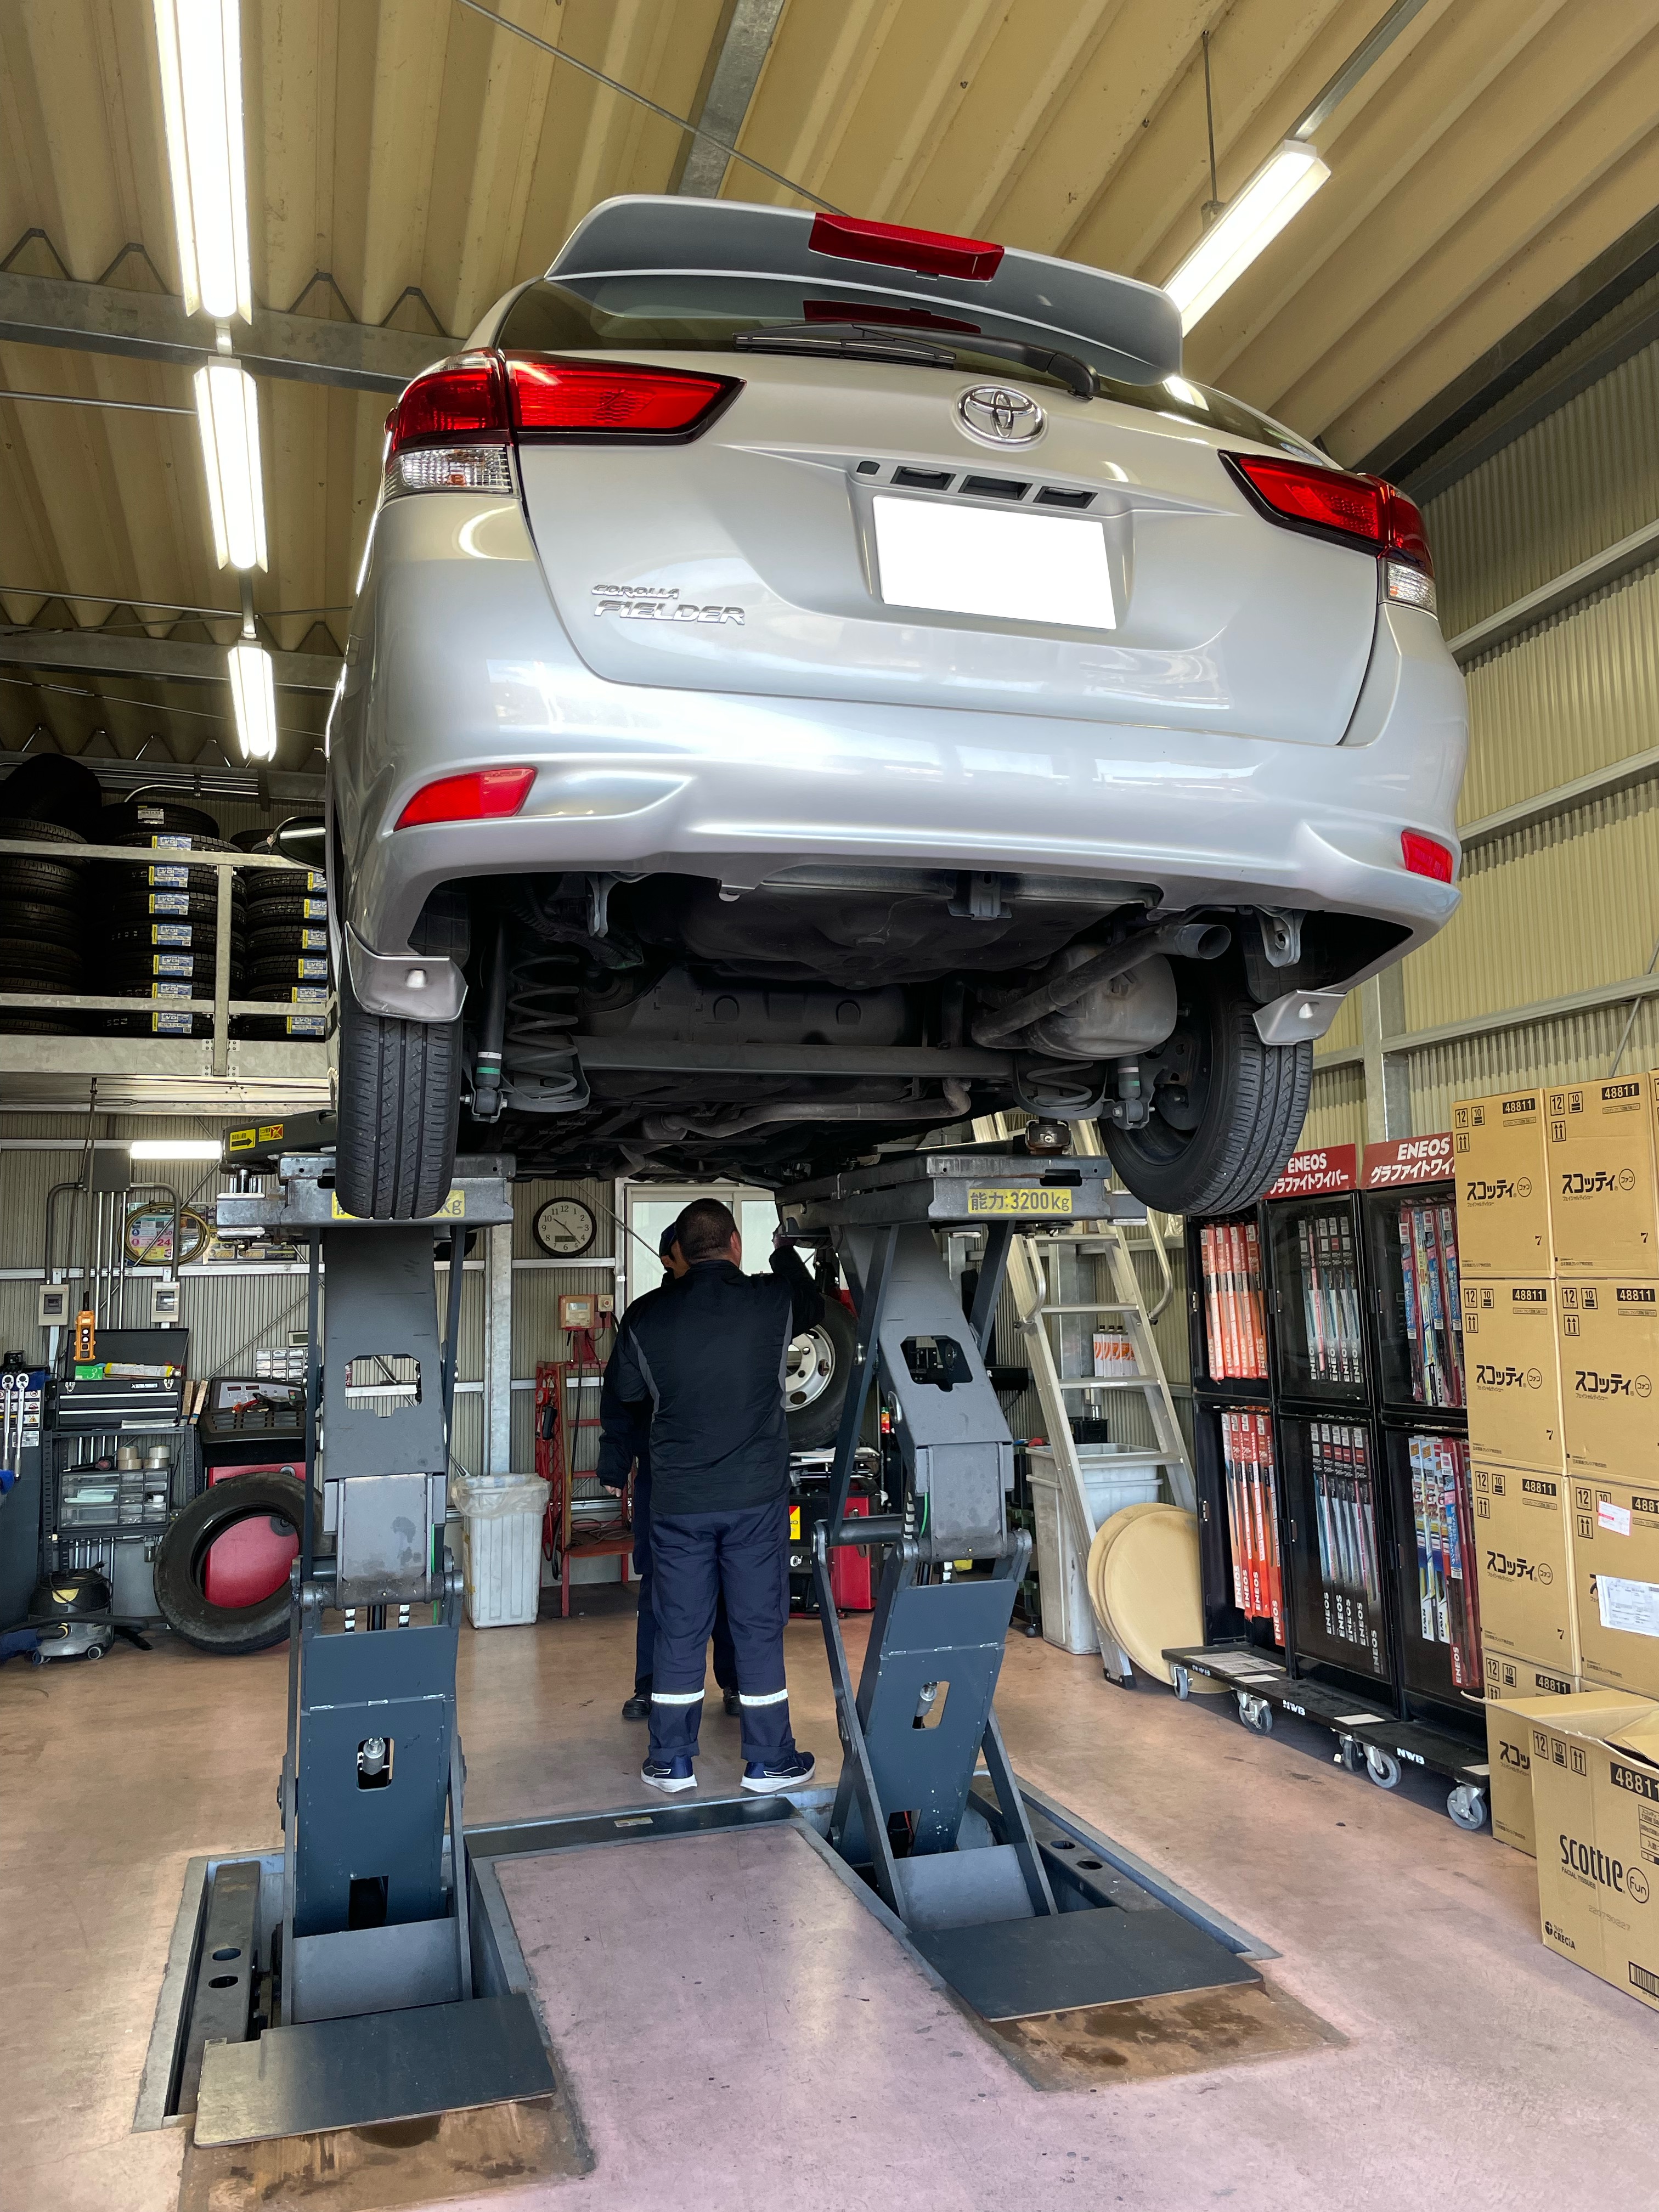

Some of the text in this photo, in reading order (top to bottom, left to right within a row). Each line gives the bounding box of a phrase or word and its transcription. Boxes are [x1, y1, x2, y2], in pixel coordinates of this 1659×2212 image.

[592, 584, 679, 599] COROLLA
[594, 600, 745, 625] FIELDER
[1571, 1094, 1579, 1103] 10
[1605, 1085, 1635, 1098] 48811
[1505, 1100, 1532, 1113] 48811
[1552, 1097, 1562, 1110] 12
[1457, 1110, 1466, 1123] 12
[1397, 1137, 1451, 1161] ENEOS
[1288, 1152, 1327, 1173] ENEOS
[1370, 1156, 1455, 1184] グラファイトワイ
[1466, 1180, 1515, 1200] スコッティ
[1562, 1171, 1616, 1194] スコッティ
[970, 1192, 1070, 1211] 能力:3200kg
[1535, 1235, 1542, 1246] 7
[1640, 1232, 1649, 1243] 7
[1466, 1290, 1475, 1303] 12
[1484, 1290, 1491, 1299] 10
[1515, 1290, 1543, 1301] 48811
[1564, 1290, 1575, 1303] 12
[1585, 1290, 1593, 1299] 10
[1620, 1289, 1651, 1301] 48811
[1476, 1364, 1524, 1387] スコッティ
[1575, 1370, 1632, 1396] スコッティ
[1546, 1429, 1554, 1440] 7
[1477, 1473, 1486, 1487] 12
[1495, 1477, 1502, 1486] 10
[1525, 1480, 1553, 1495] 48811
[1578, 1490, 1588, 1504] 12
[1599, 1493, 1607, 1502] 10
[1635, 1498, 1659, 1513] 4881
[1487, 1550, 1535, 1582] スコッティ
[1272, 1600, 1282, 1640] ENEOS
[1324, 1592, 1332, 1634] ENEOS
[1336, 1595, 1345, 1638] ENEOS
[1346, 1599, 1354, 1642] ENEOS
[1357, 1602, 1366, 1646] ENEOS
[1557, 1628, 1564, 1640] 7
[1371, 1630, 1380, 1673] ENEOS
[1453, 1646, 1463, 1684] ENEOS
[1488, 1660, 1497, 1675] 12
[1505, 1666, 1513, 1677] 10
[1538, 1676, 1567, 1694] 48811
[1283, 1700, 1306, 1716] NWB
[1535, 1735, 1546, 1752] 12
[1555, 1742, 1562, 1754] 10
[1397, 1747, 1425, 1765] NWB
[1499, 1740, 1531, 1770] スコッ
[1616, 1767, 1659, 1801] 48811
[1561, 1866, 1596, 1889] FACIAL TISSUES
